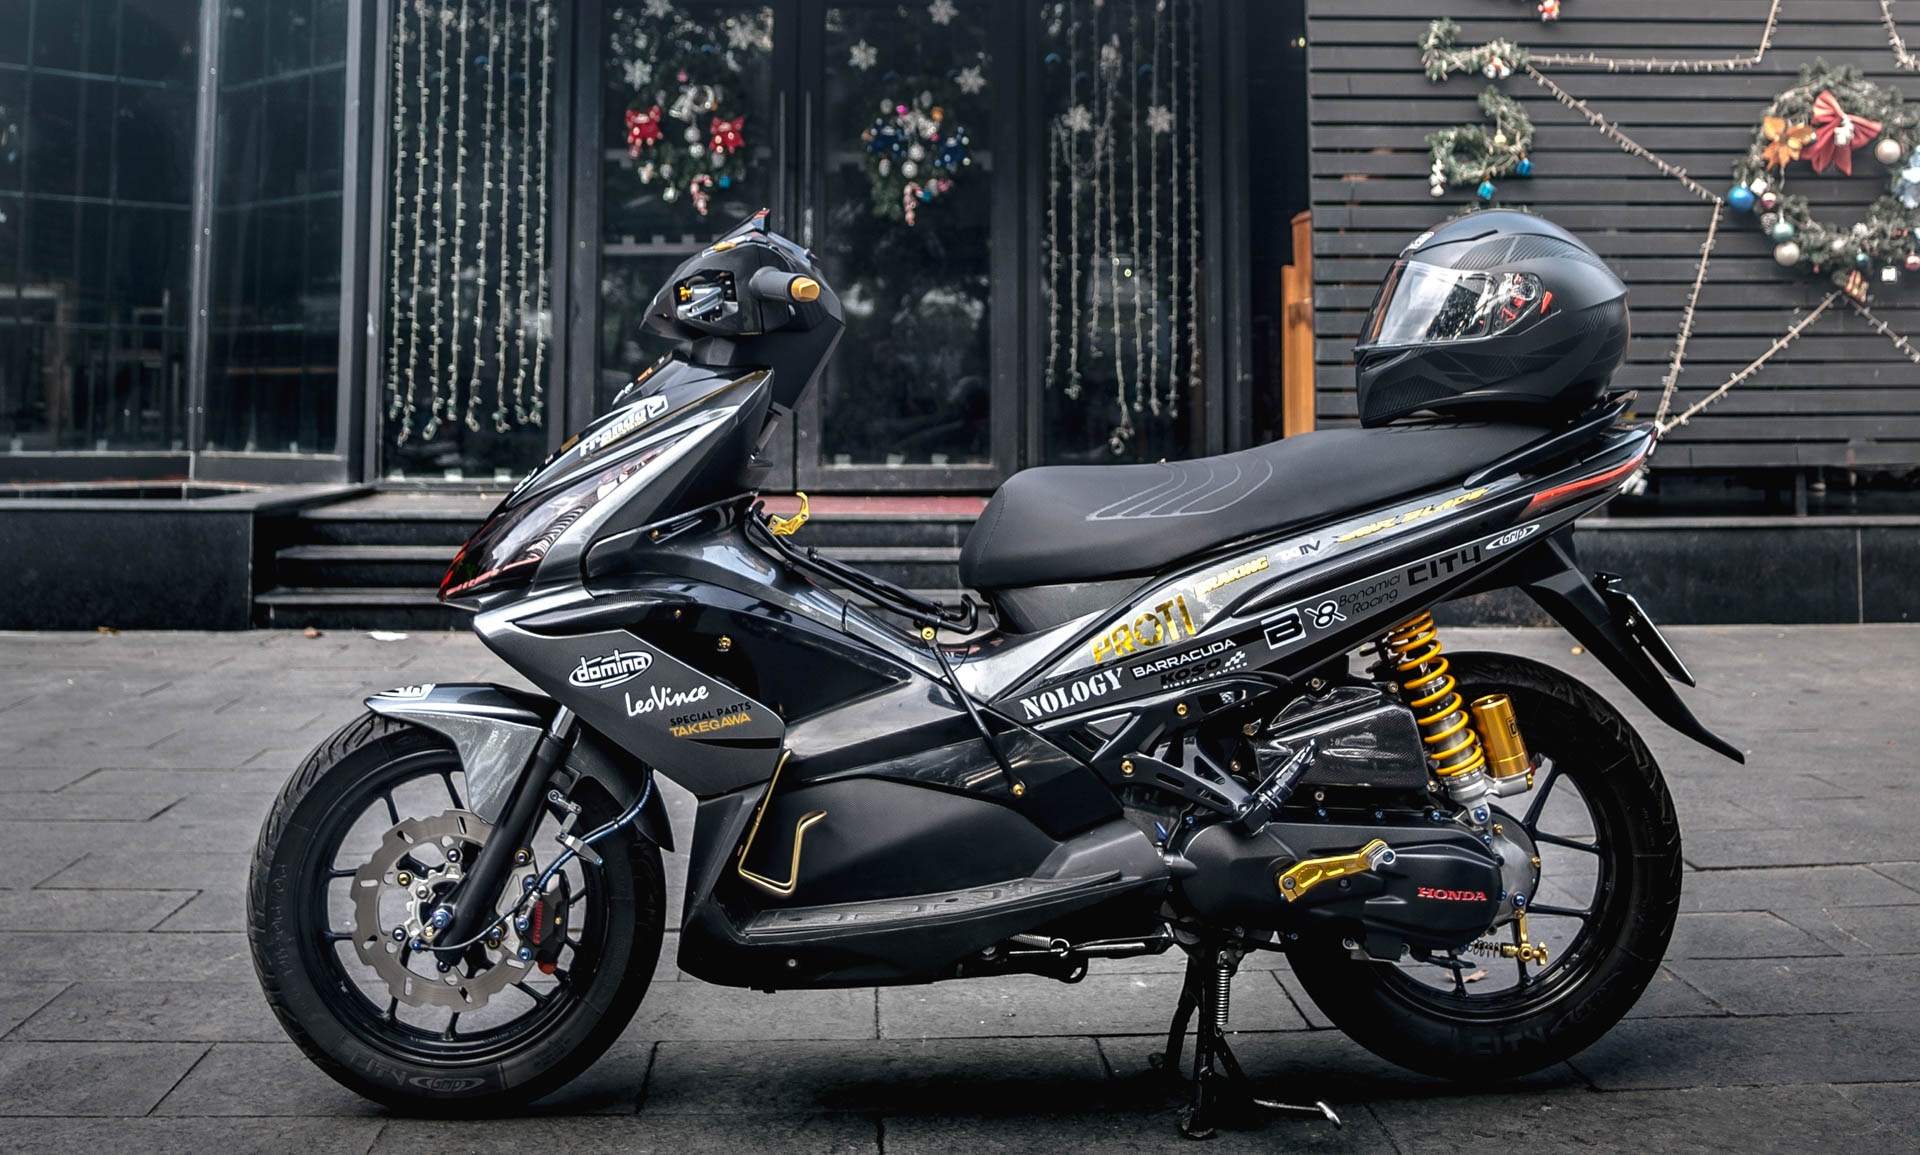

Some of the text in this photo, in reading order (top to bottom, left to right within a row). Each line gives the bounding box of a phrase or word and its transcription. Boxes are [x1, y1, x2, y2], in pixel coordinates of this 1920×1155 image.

[1407, 545, 1481, 586] CITY
[1352, 589, 1398, 615] Racing
[1090, 594, 1196, 664] PROTI
[576, 650, 647, 682] domino
[1132, 639, 1237, 678] BARRACUDA
[1160, 658, 1222, 685] KOSO
[625, 685, 710, 717] LeoVince
[1019, 667, 1124, 720] NOLOGY
[669, 713, 752, 737] TAKEGAWA
[670, 702, 752, 726] SPECIAL PARTS
[1417, 887, 1488, 901] HONDA
